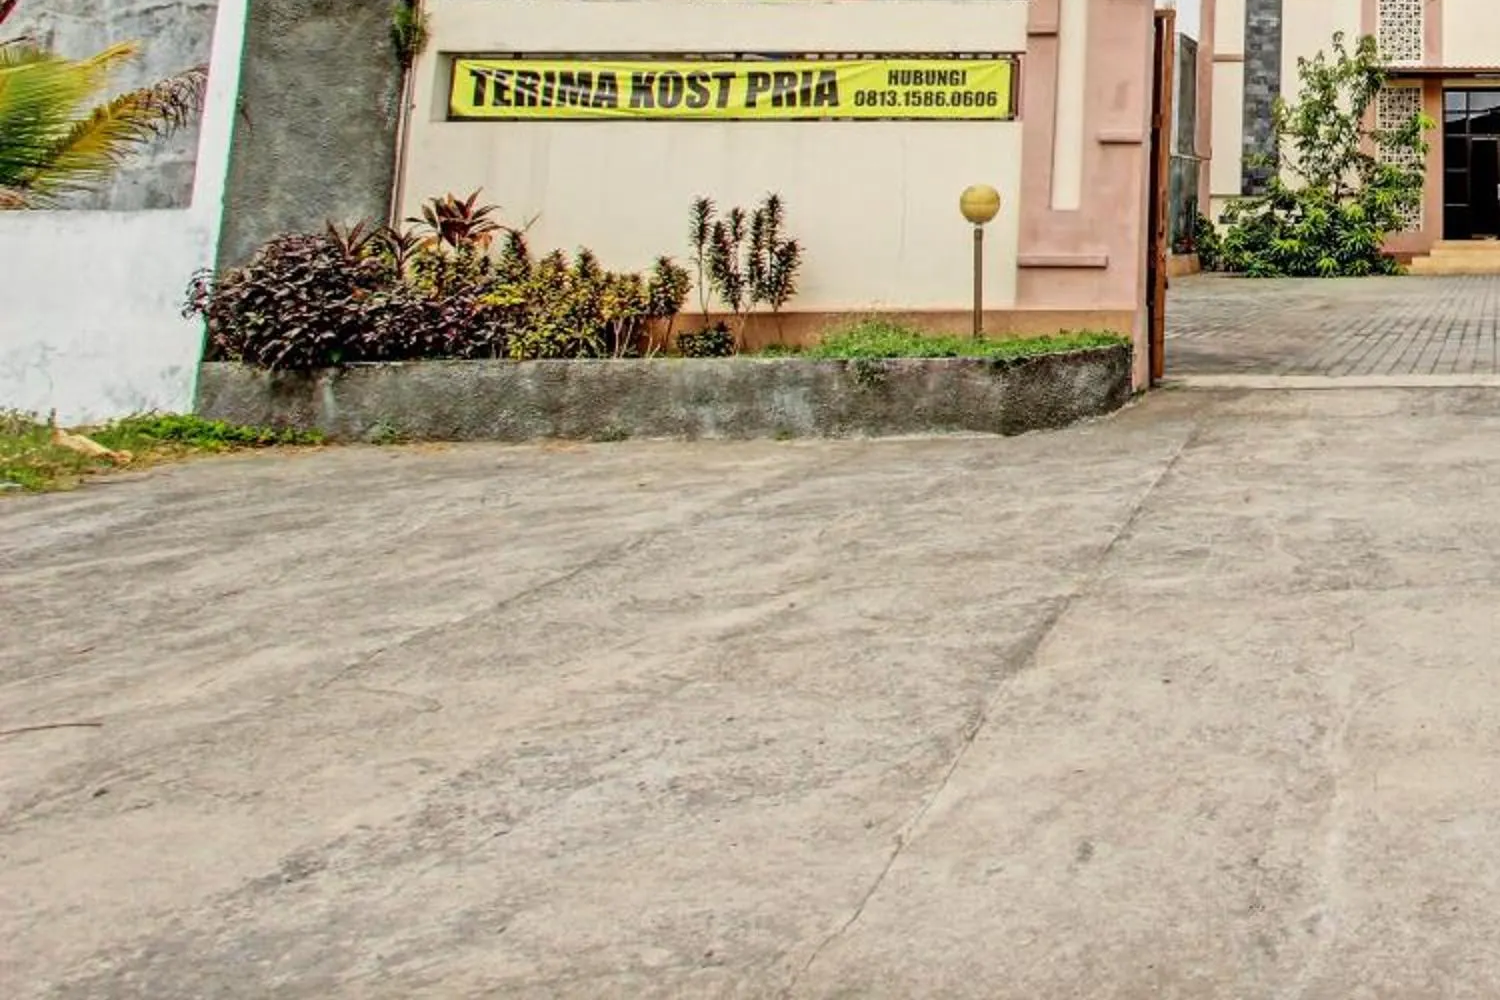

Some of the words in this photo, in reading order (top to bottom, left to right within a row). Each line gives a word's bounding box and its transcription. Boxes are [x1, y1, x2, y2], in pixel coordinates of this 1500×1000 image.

[887, 69, 967, 86] HUBUNGI
[470, 69, 619, 108] TERIMA
[630, 69, 737, 109] KOST
[745, 70, 839, 108] PRIA
[854, 89, 998, 107] 0813.1586.0606
